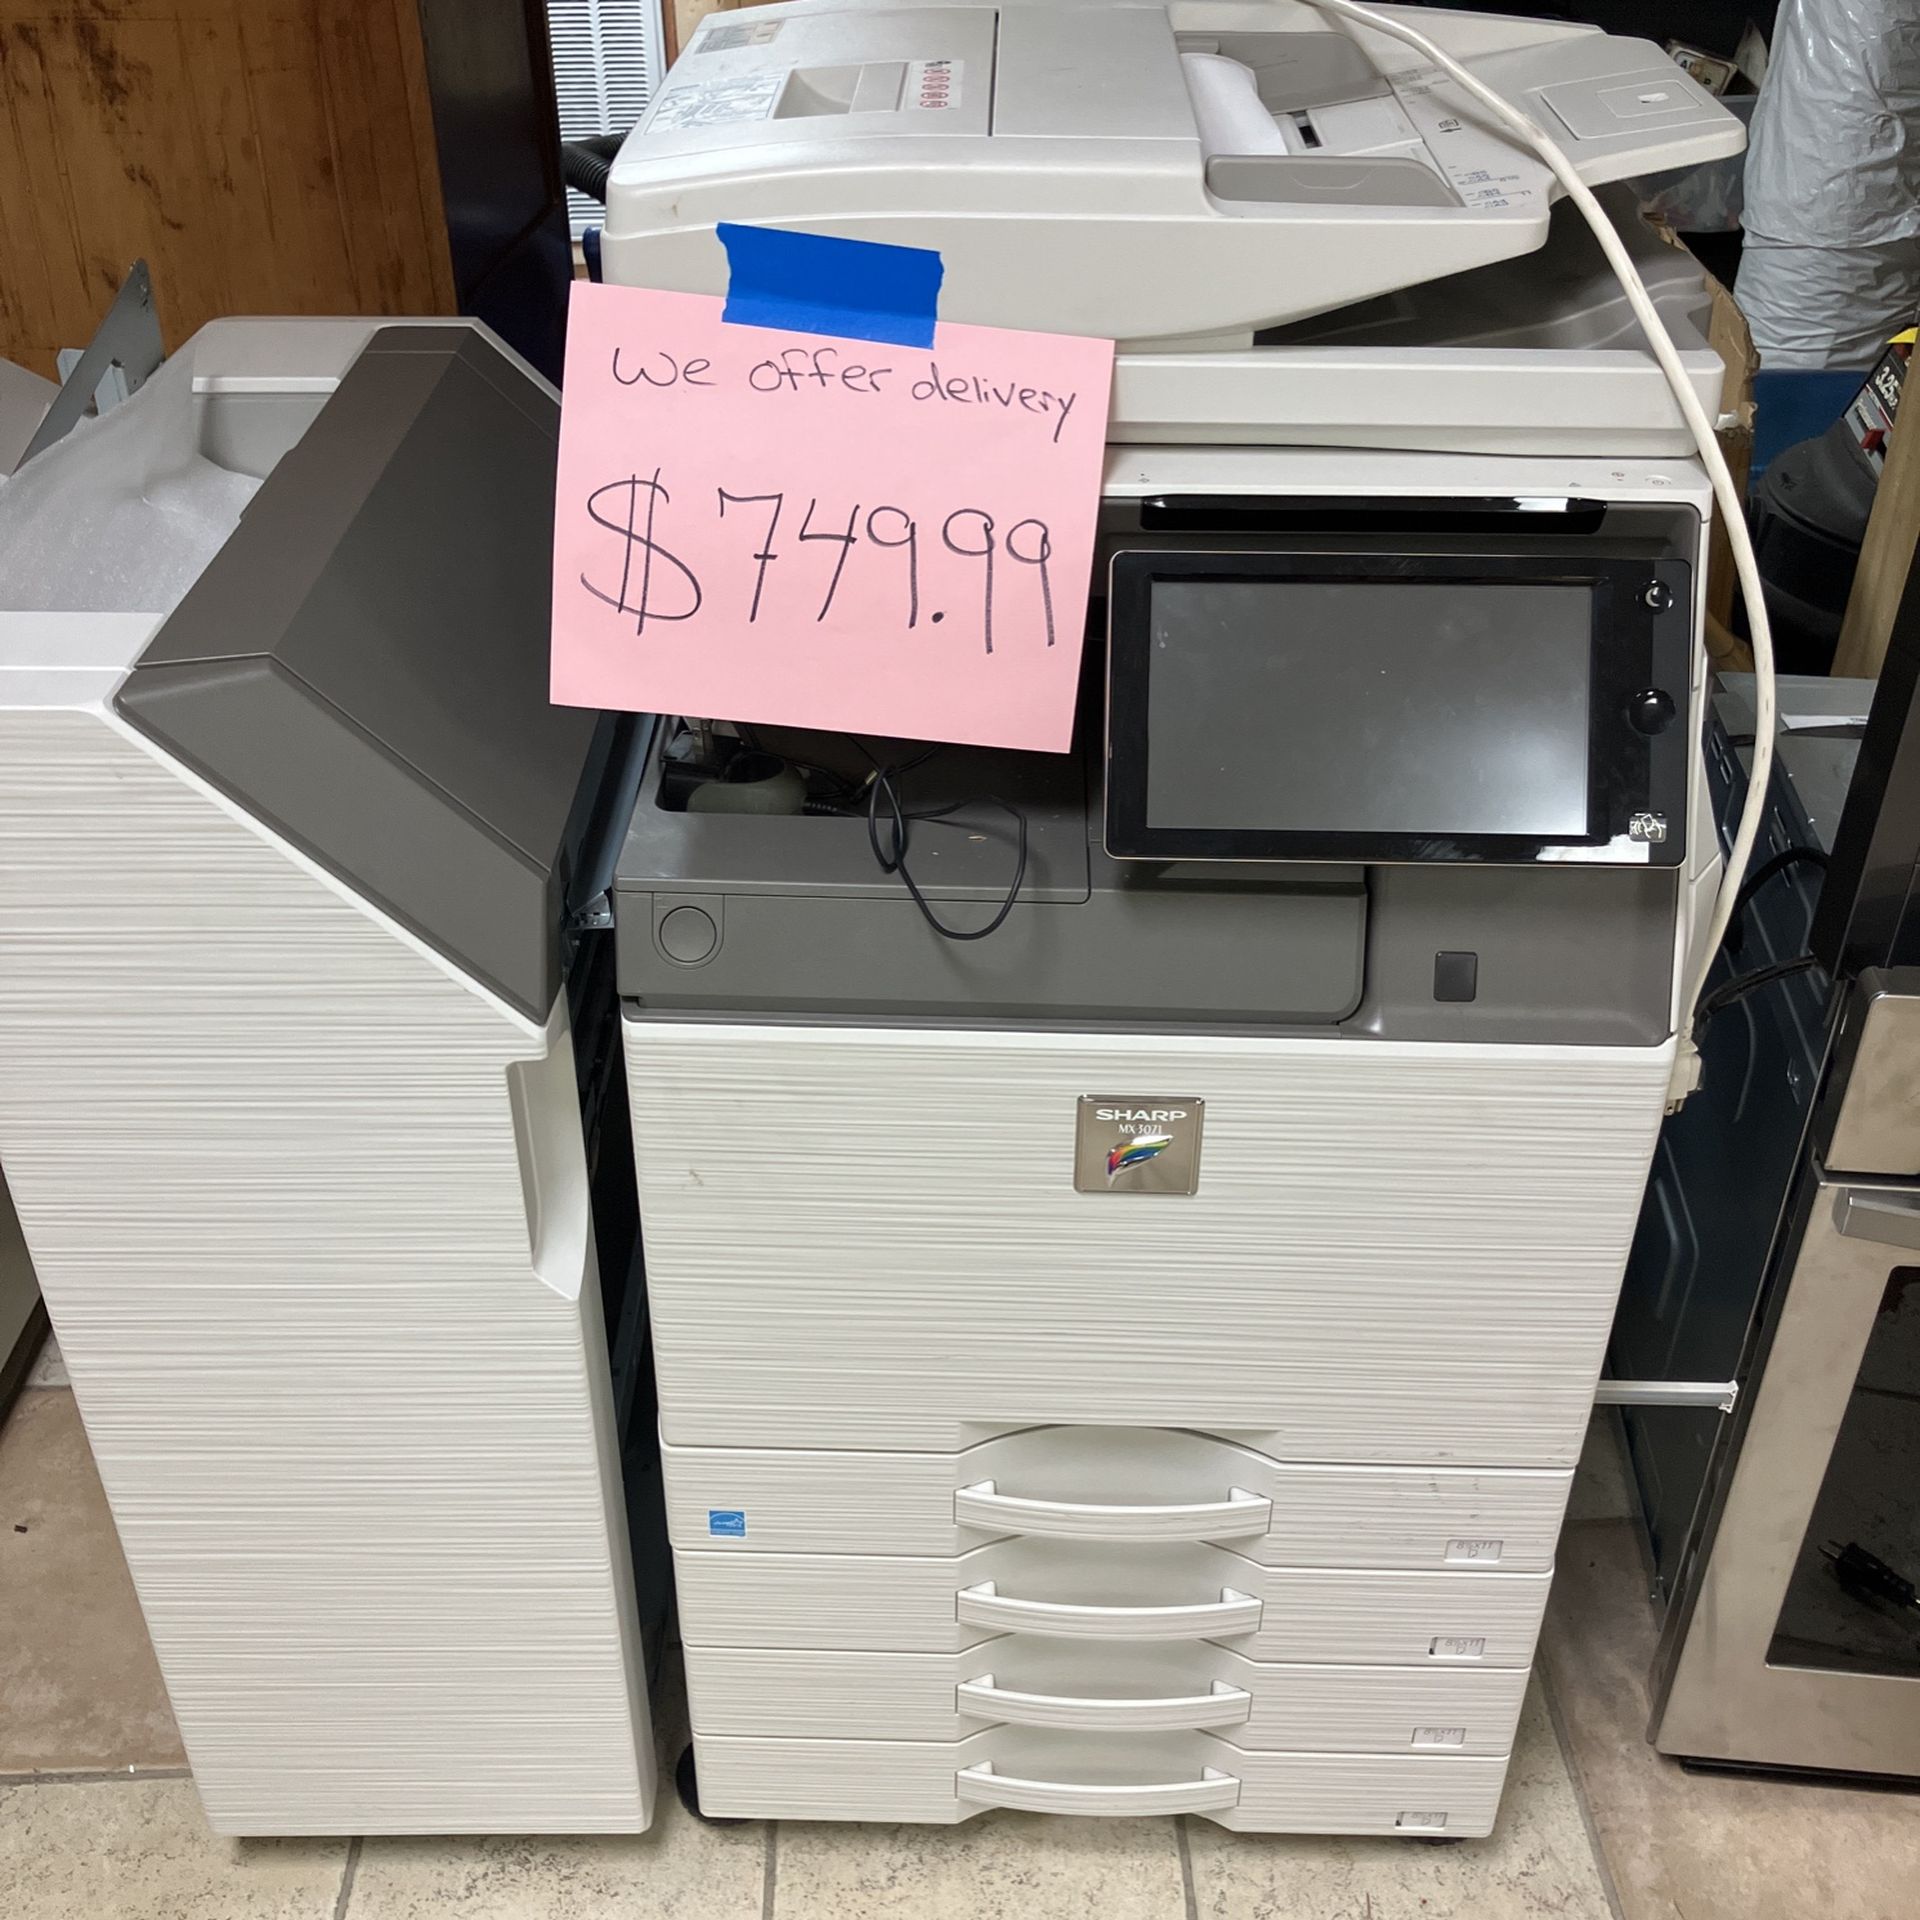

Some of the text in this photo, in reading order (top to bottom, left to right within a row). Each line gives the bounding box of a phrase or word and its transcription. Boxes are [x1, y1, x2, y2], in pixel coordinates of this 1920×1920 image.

[613, 347, 1077, 442] We offer delivery
[580, 468, 1056, 654] $749.99
[1095, 1109, 1187, 1121] SHARP
